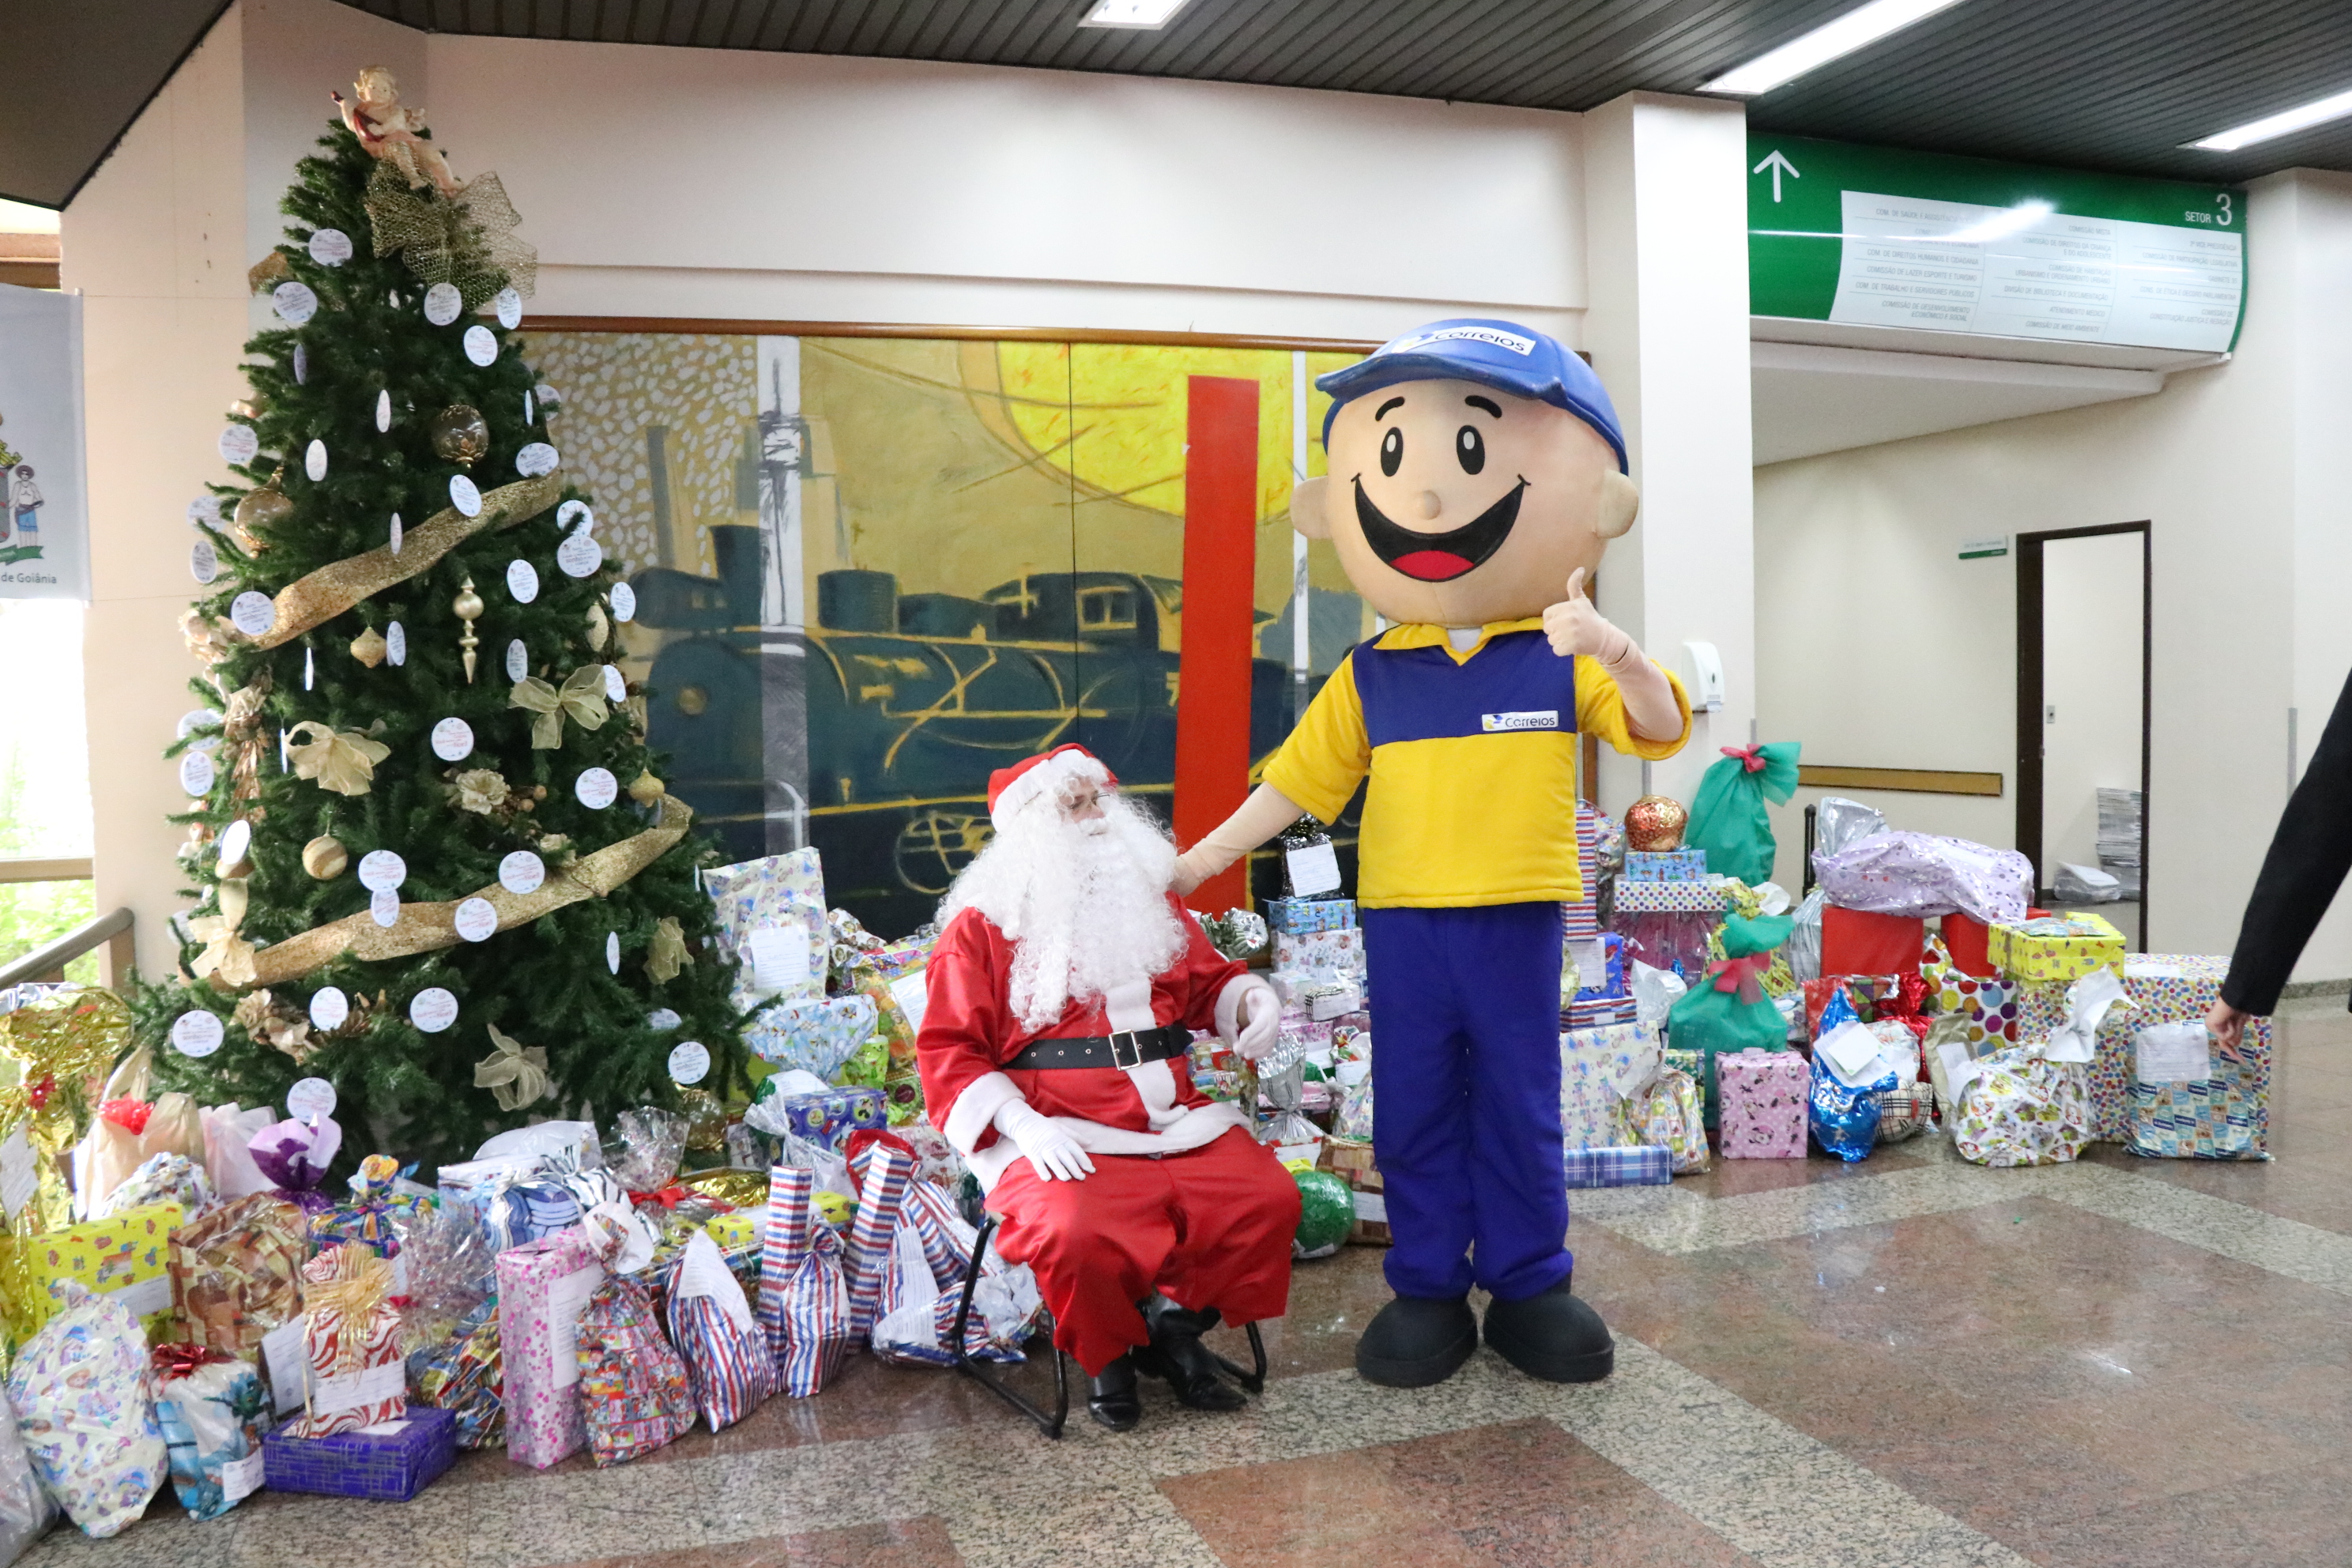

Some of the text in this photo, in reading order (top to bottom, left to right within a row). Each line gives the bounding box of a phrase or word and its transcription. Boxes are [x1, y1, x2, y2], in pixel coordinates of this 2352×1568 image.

[2185, 193, 2233, 226] SETOR 3
[1892, 251, 1917, 259] DIREITOS
[1917, 253, 1944, 262] HUMANOS
[1951, 256, 1979, 265] CIDADANIA
[1867, 265, 1896, 274] COMISSÃO
[1924, 270, 1947, 279] ESPORTE
[1954, 273, 1977, 282] TURISMO
[1881, 283, 1909, 292] TRABALHO
[1915, 286, 1947, 296] SERVIDORES
[2034, 288, 2062, 296] BIBLIOTECA
[2067, 291, 2108, 301] DOCUMENTAÇÃO
[1882, 300, 1911, 309] COMISSÃO
[1920, 303, 1970, 313] DESENVOLVIMENTO
[1435, 331, 1525, 352] Correios
[1, 572, 57, 584] de Goiânia
[1505, 717, 1555, 728] Correios
